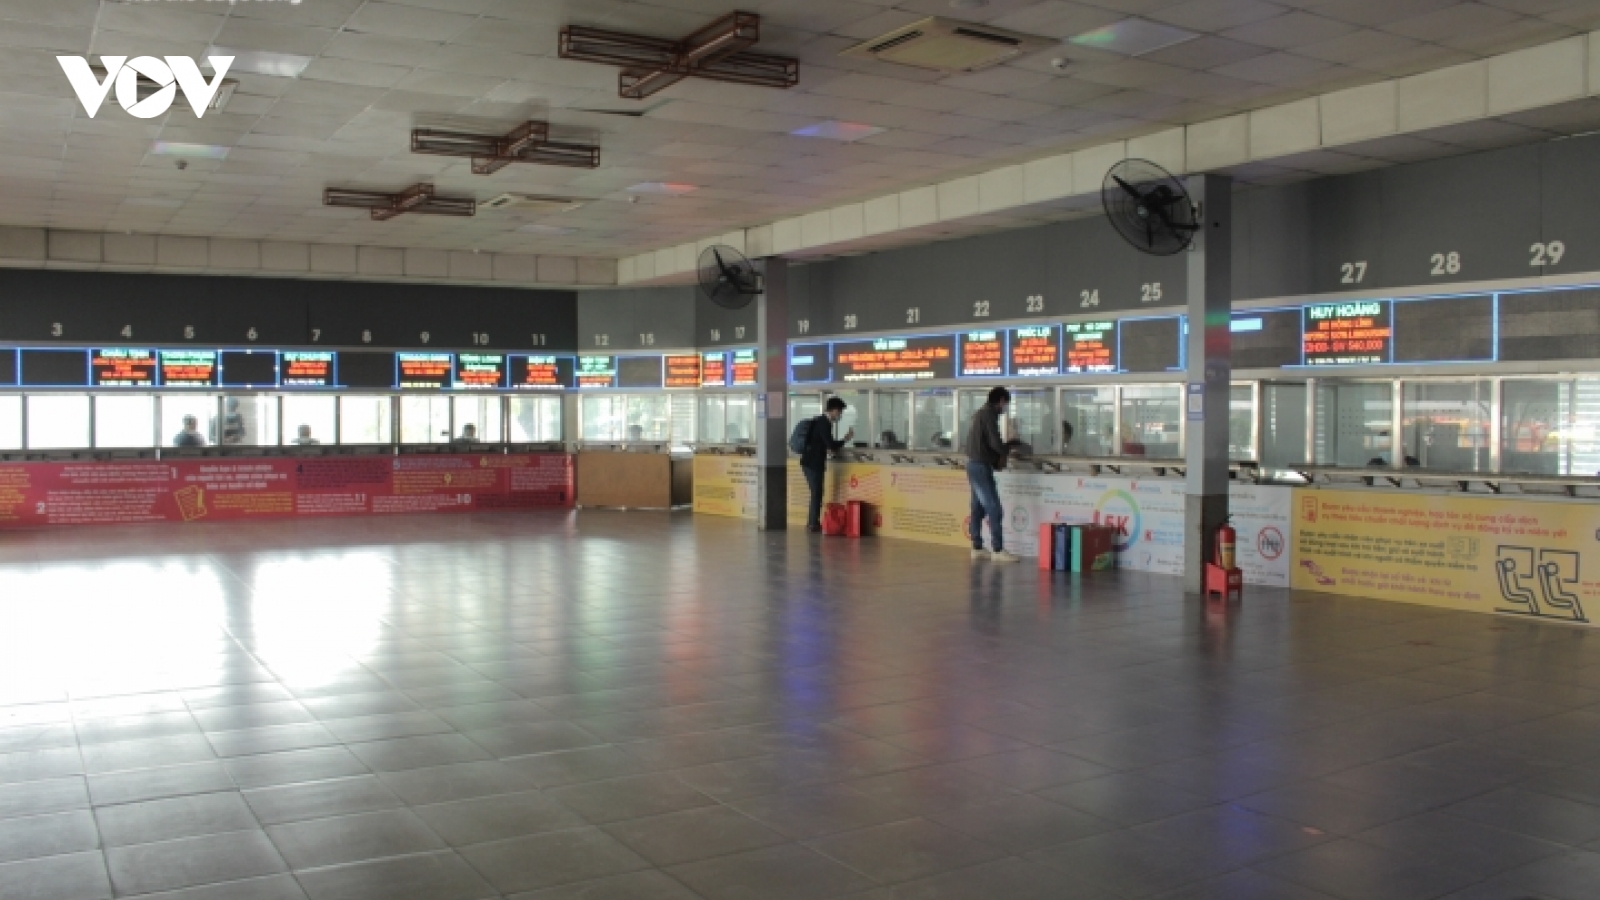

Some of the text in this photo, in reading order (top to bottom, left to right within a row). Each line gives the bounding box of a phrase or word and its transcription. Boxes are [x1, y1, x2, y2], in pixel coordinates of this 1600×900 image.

[1529, 241, 1565, 266] 29
[1431, 251, 1461, 275] 28
[1341, 261, 1368, 284] 27
[1080, 289, 1099, 308] 24
[1141, 282, 1161, 302] 25
[973, 300, 991, 317] 22
[1027, 295, 1043, 313] 23
[906, 308, 920, 323] 21
[1311, 306, 1334, 319] HUY
[51, 322, 63, 337] 3
[844, 314, 857, 330] 20
[120, 324, 132, 338] 4
[247, 327, 258, 341] 6
[311, 328, 322, 342] 7
[361, 329, 372, 343] 8
[420, 331, 430, 344] 9
[473, 332, 490, 346] 10
[531, 333, 546, 346] 11
